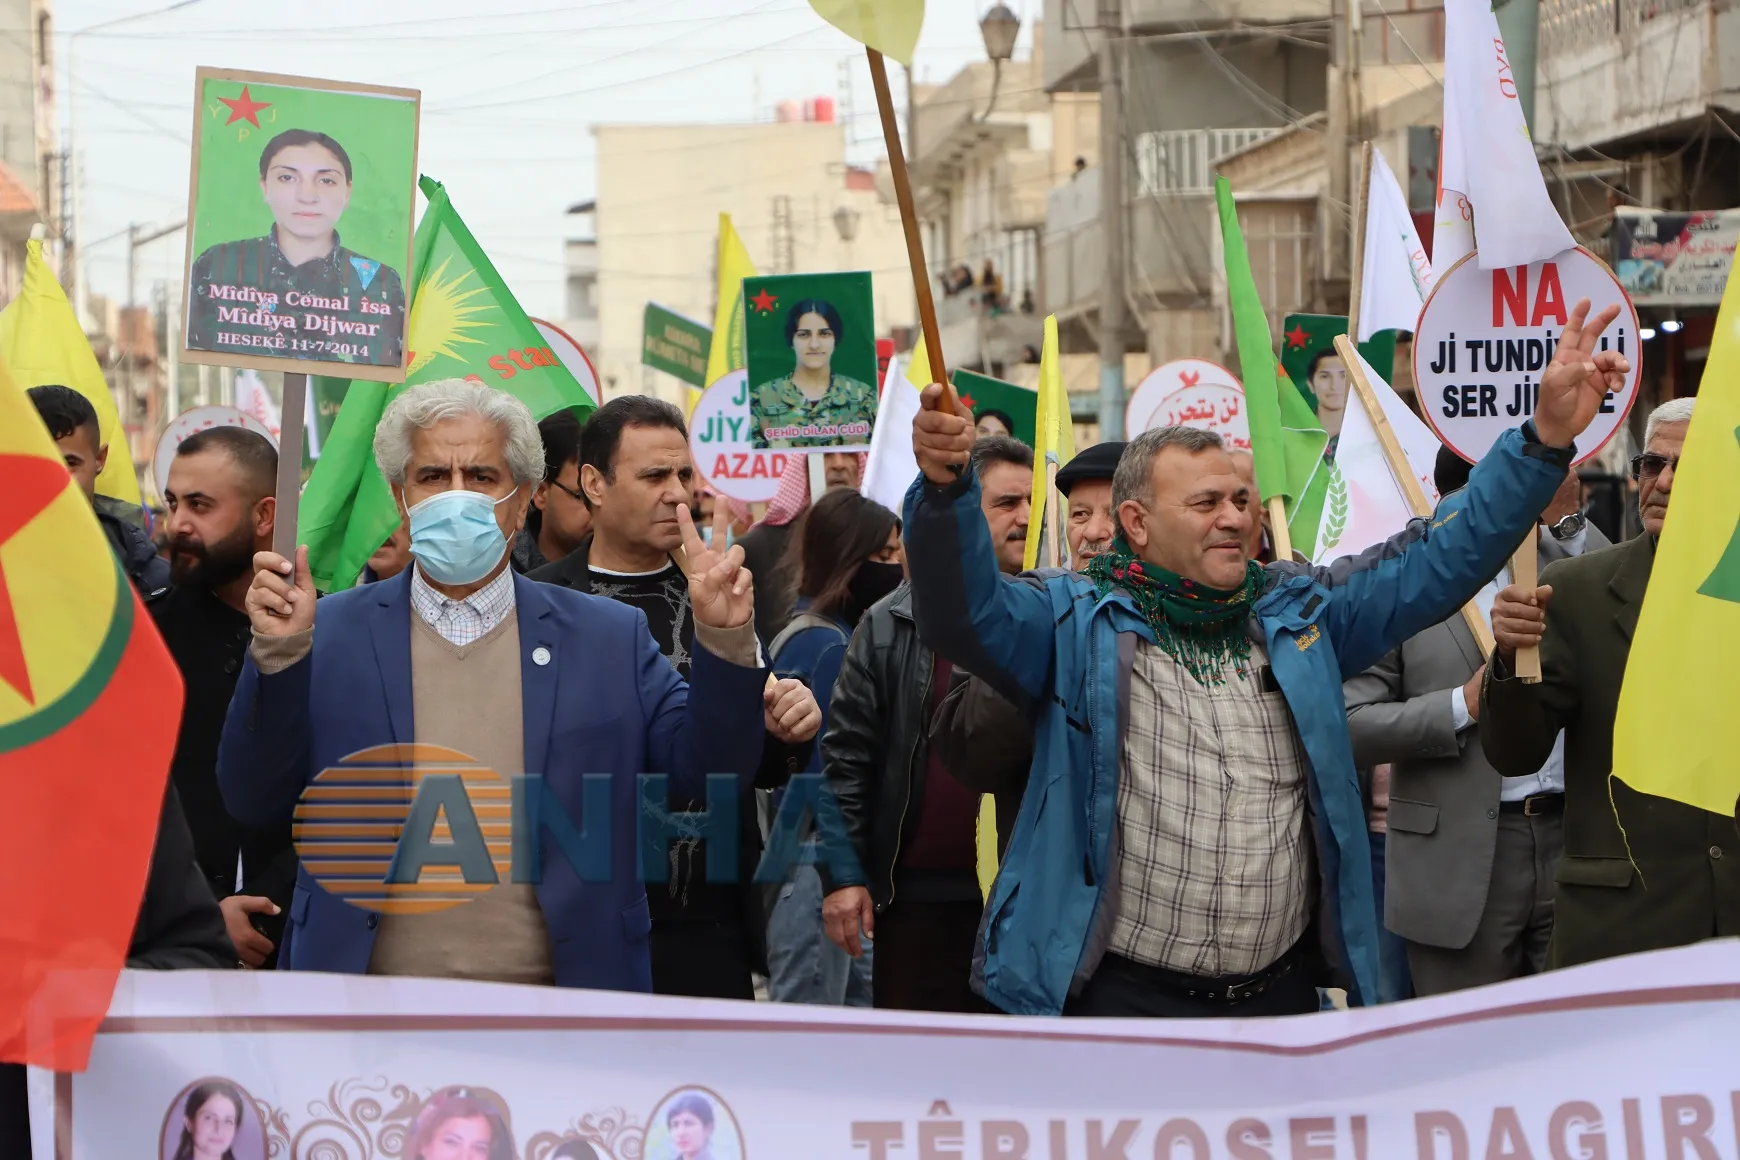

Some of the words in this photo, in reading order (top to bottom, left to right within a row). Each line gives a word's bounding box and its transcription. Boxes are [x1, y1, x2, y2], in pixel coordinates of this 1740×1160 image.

[285, 291, 349, 311] Cemal
[1493, 262, 1569, 327] NA
[304, 314, 379, 337] Dijwar
[217, 332, 285, 349] HESEKÊ
[291, 339, 369, 357] 11-7-2014
[1442, 384, 1498, 419] SER
